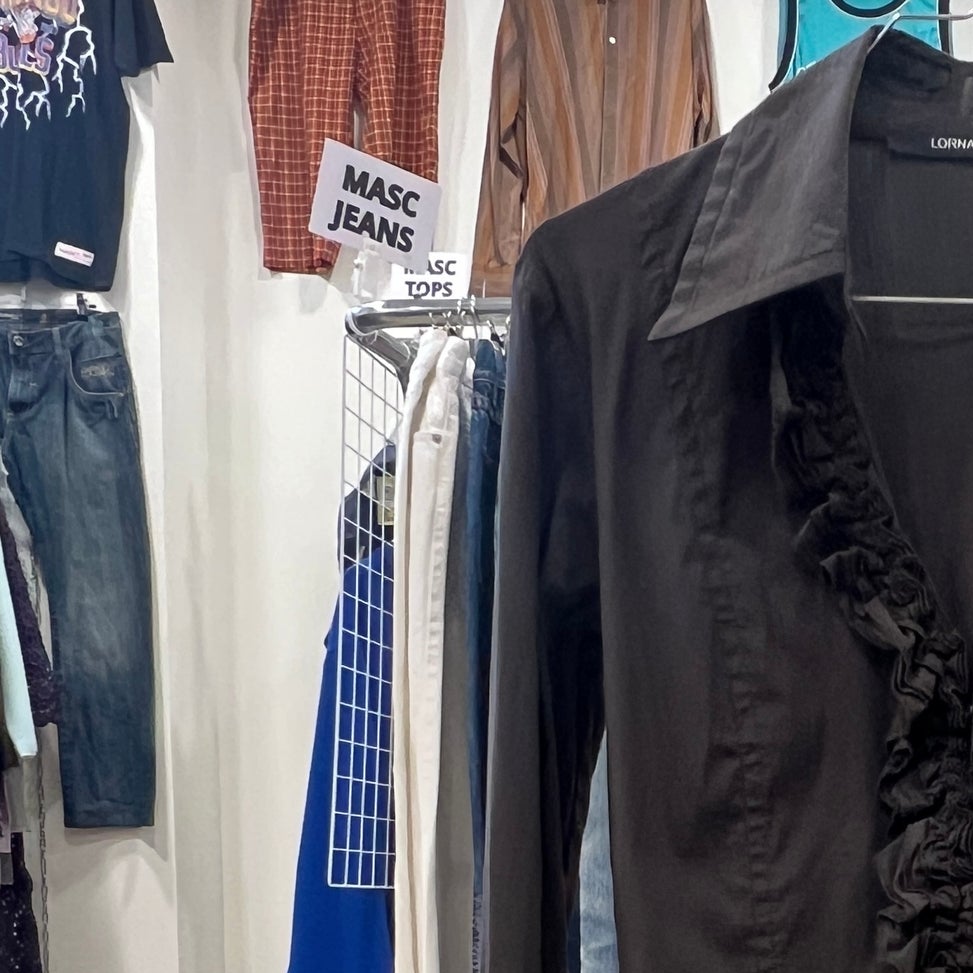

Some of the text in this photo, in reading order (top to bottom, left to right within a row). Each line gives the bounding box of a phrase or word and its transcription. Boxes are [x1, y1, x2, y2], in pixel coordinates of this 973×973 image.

[342, 164, 420, 218] MASC
[327, 199, 415, 253] JEANS
[404, 259, 457, 275] ASC
[405, 281, 453, 298] TOPS
